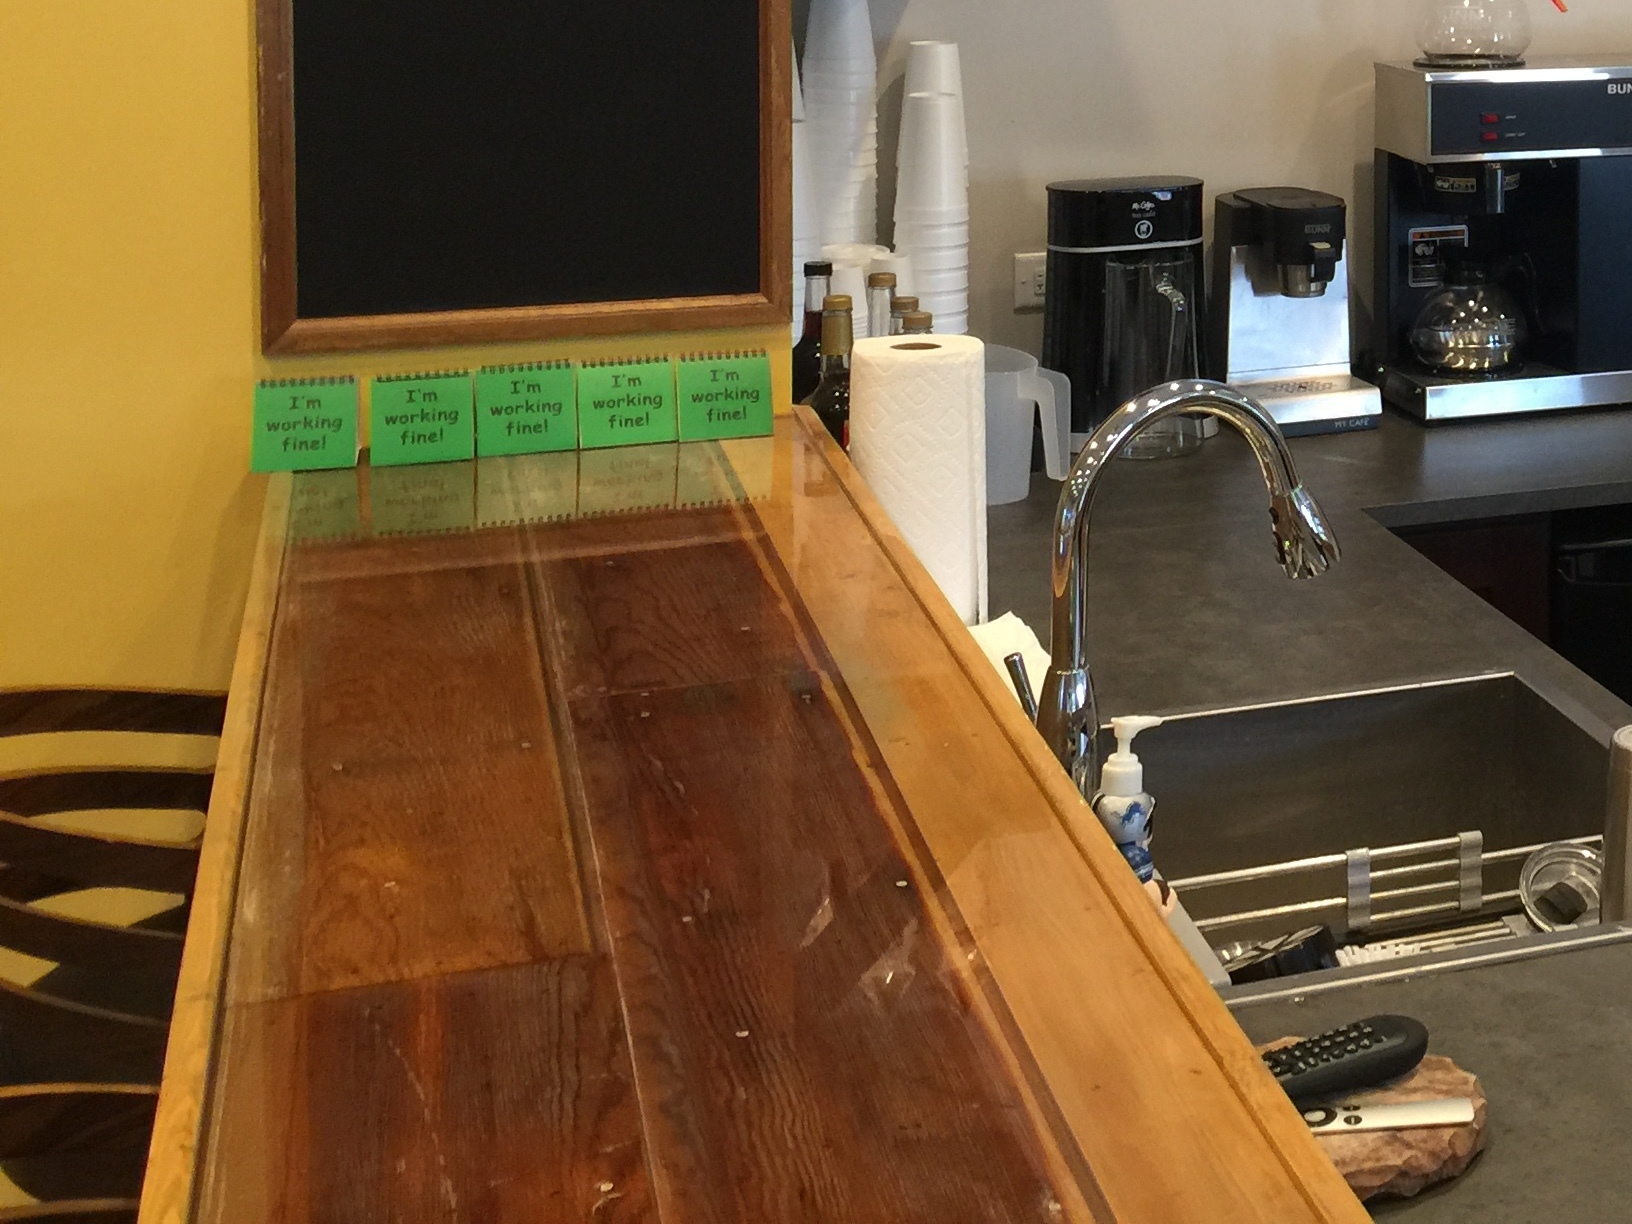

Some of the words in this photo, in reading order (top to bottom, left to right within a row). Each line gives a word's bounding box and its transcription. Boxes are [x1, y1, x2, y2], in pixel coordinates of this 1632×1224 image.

[611, 373, 642, 388] I'm
[709, 368, 740, 383] I'm
[510, 378, 542, 394] I'm
[288, 394, 322, 411] I'm
[406, 388, 439, 404] I'm
[592, 391, 664, 411] working
[690, 387, 760, 406] working
[489, 398, 563, 418] working
[706, 405, 748, 424] fine!
[265, 415, 344, 434] working
[384, 408, 460, 428] working
[607, 411, 650, 430] fine!
[399, 427, 444, 447] fine!
[505, 418, 549, 438] fine!
[281, 434, 328, 454] fine!
